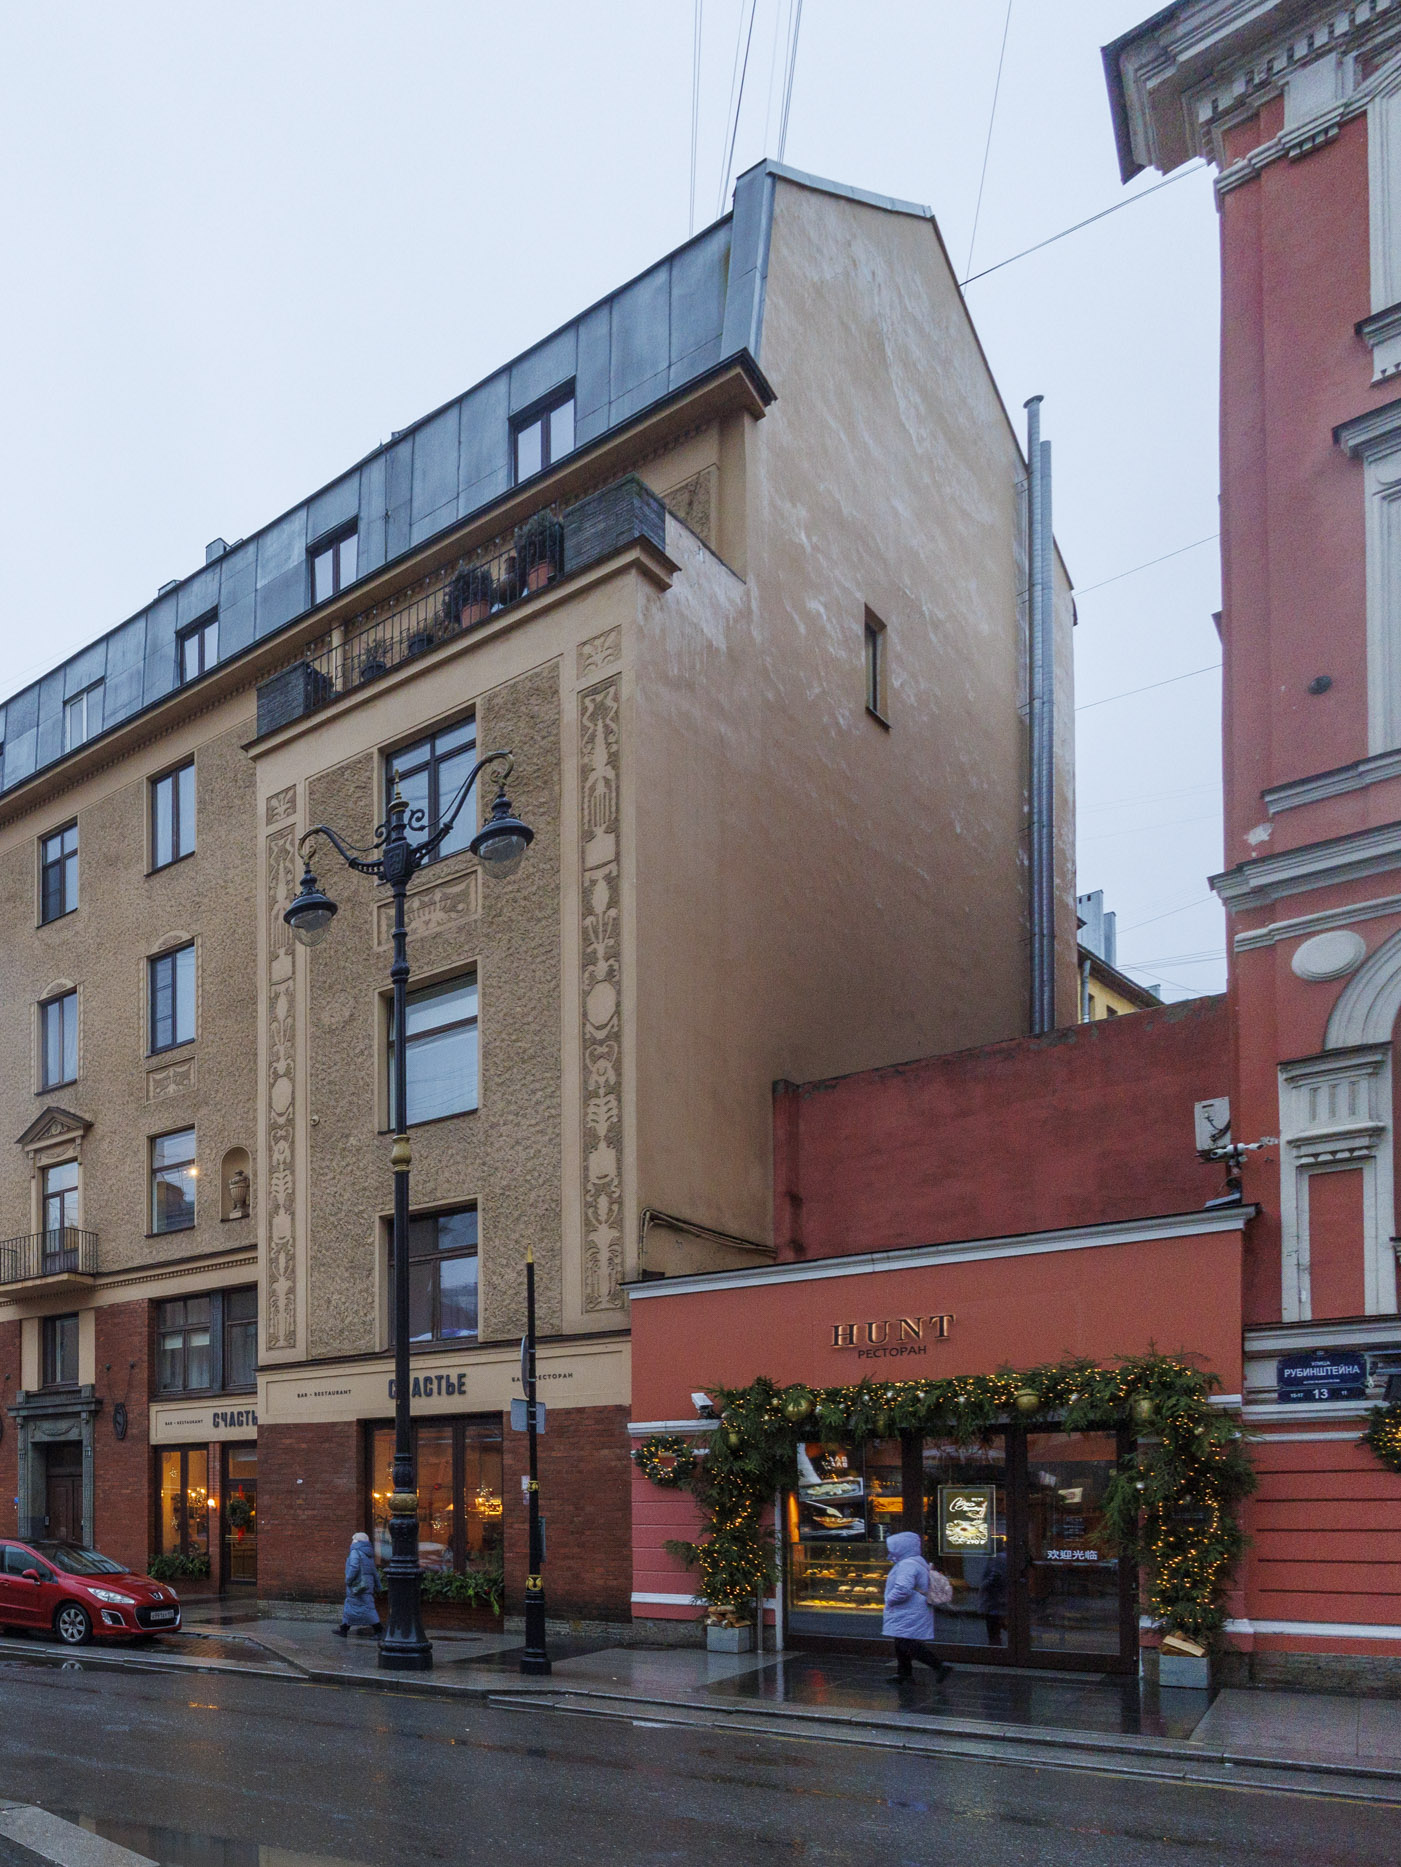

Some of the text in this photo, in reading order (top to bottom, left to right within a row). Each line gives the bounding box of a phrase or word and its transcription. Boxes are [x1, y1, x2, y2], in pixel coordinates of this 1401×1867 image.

[830, 1314, 955, 1347] HUNT
[858, 1345, 927, 1359] РЕСТОРАН
[1284, 1365, 1360, 1377] РУБИНШТЕЙНА
[388, 1373, 467, 1400] САСТЬЕ
[314, 1389, 352, 1397] RESTAURANT
[1313, 1389, 1328, 1399] 13
[1047, 1550, 1098, 1560] 欢迎光临
